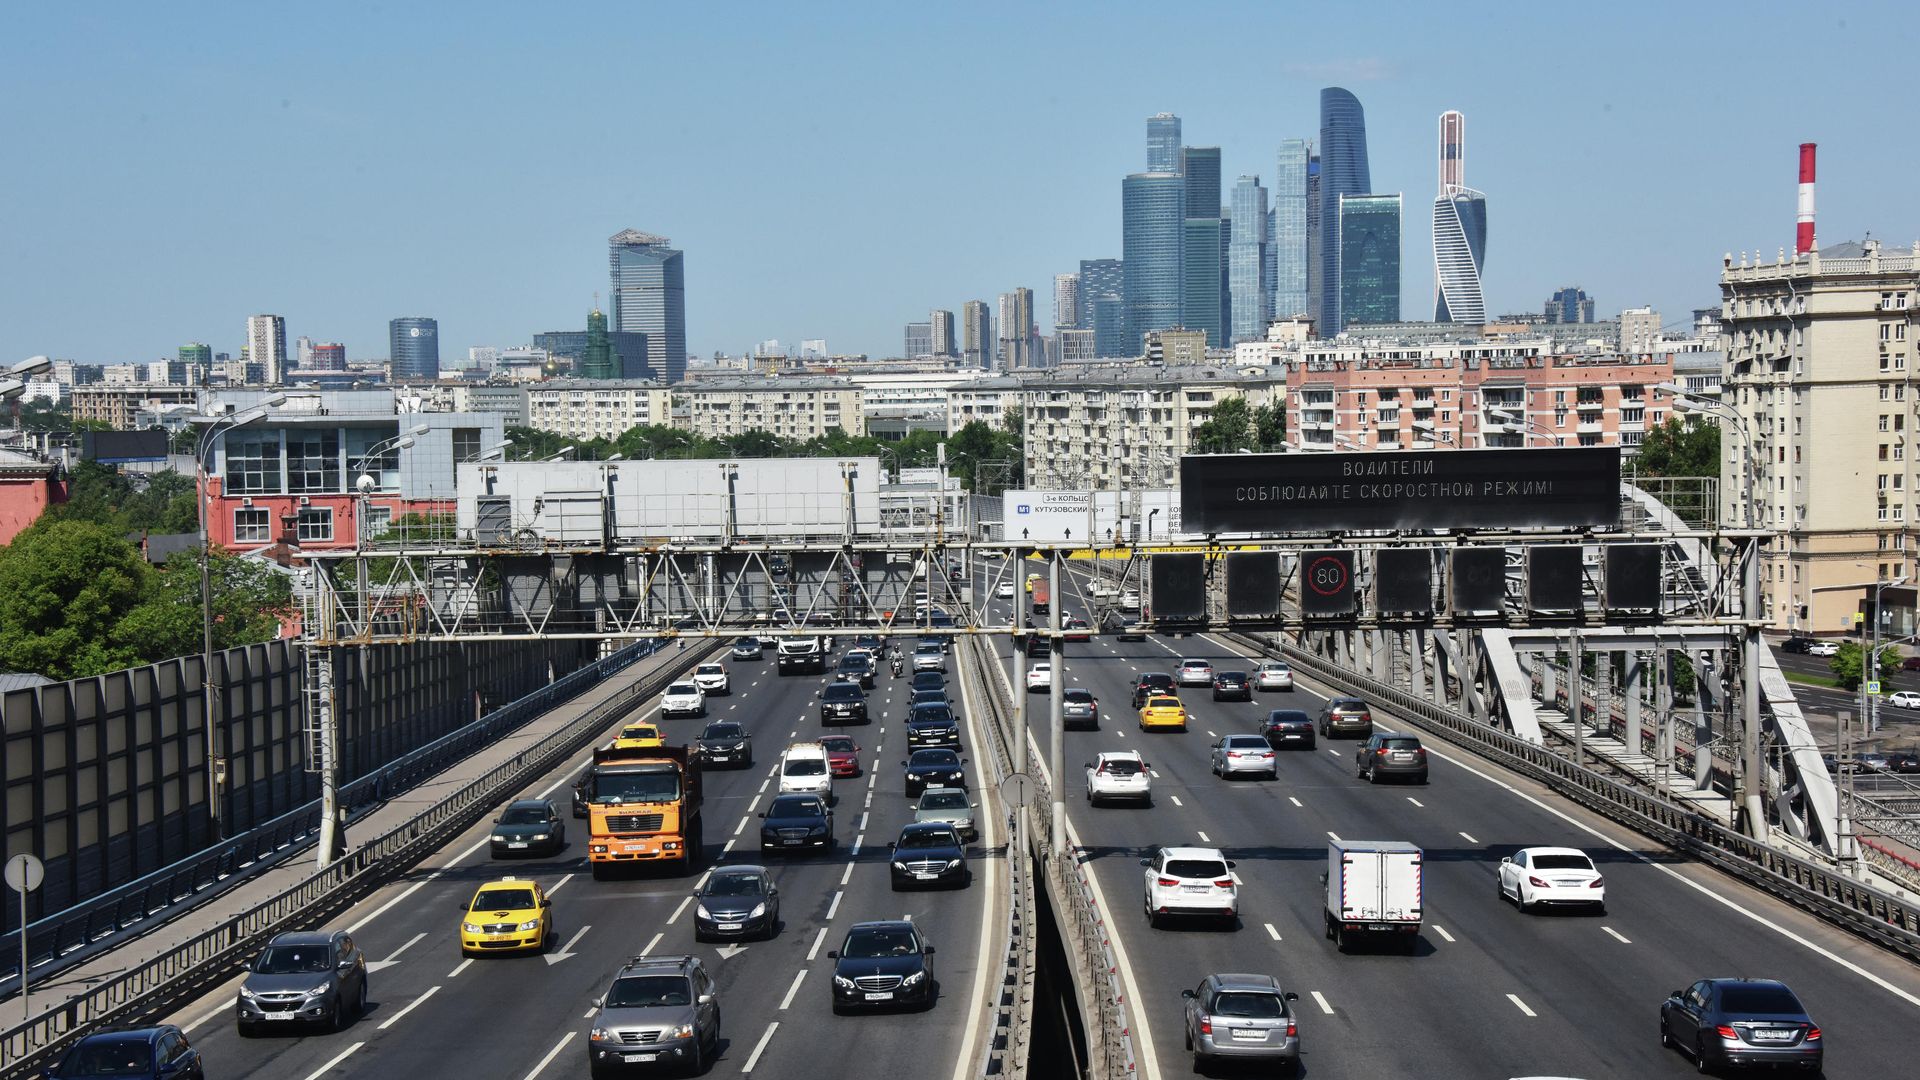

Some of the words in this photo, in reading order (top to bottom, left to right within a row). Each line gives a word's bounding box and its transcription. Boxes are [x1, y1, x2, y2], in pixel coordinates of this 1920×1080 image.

[1343, 459, 1433, 476] ВОДИТЕЛИ
[1236, 485, 1351, 502] СОБЛЮДАЙТЕ
[1360, 482, 1473, 499] СКОРОСТНОЙ
[1484, 480, 1552, 496] РЕЖИМ!
[1034, 505, 1088, 513] КУТУЗОВСКИЙ
[1317, 568, 1339, 584] 80
